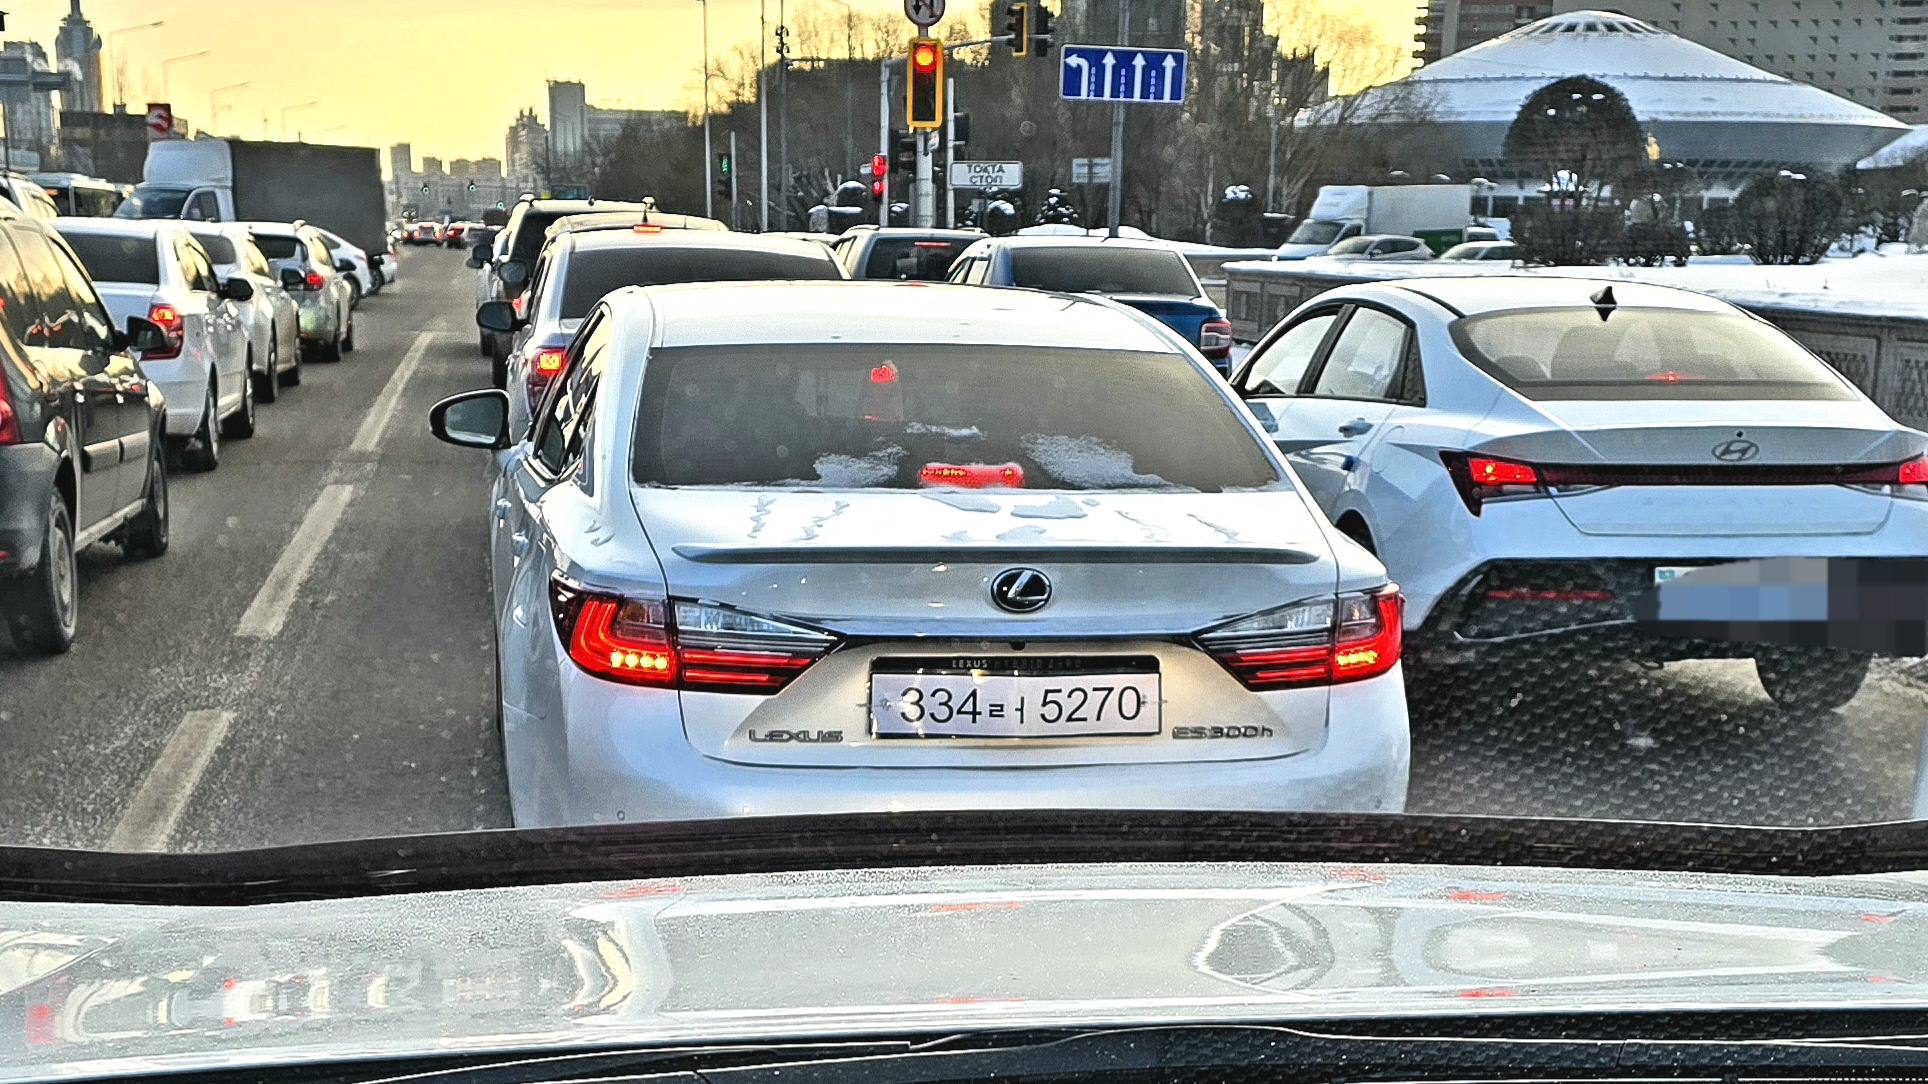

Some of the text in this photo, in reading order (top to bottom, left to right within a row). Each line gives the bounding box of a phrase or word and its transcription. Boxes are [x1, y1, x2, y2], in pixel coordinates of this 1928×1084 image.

[969, 175, 1003, 185] СТОП
[952, 659, 988, 668] LEXUS
[1039, 686, 1142, 724] 5270
[749, 729, 843, 743] LEXUS
